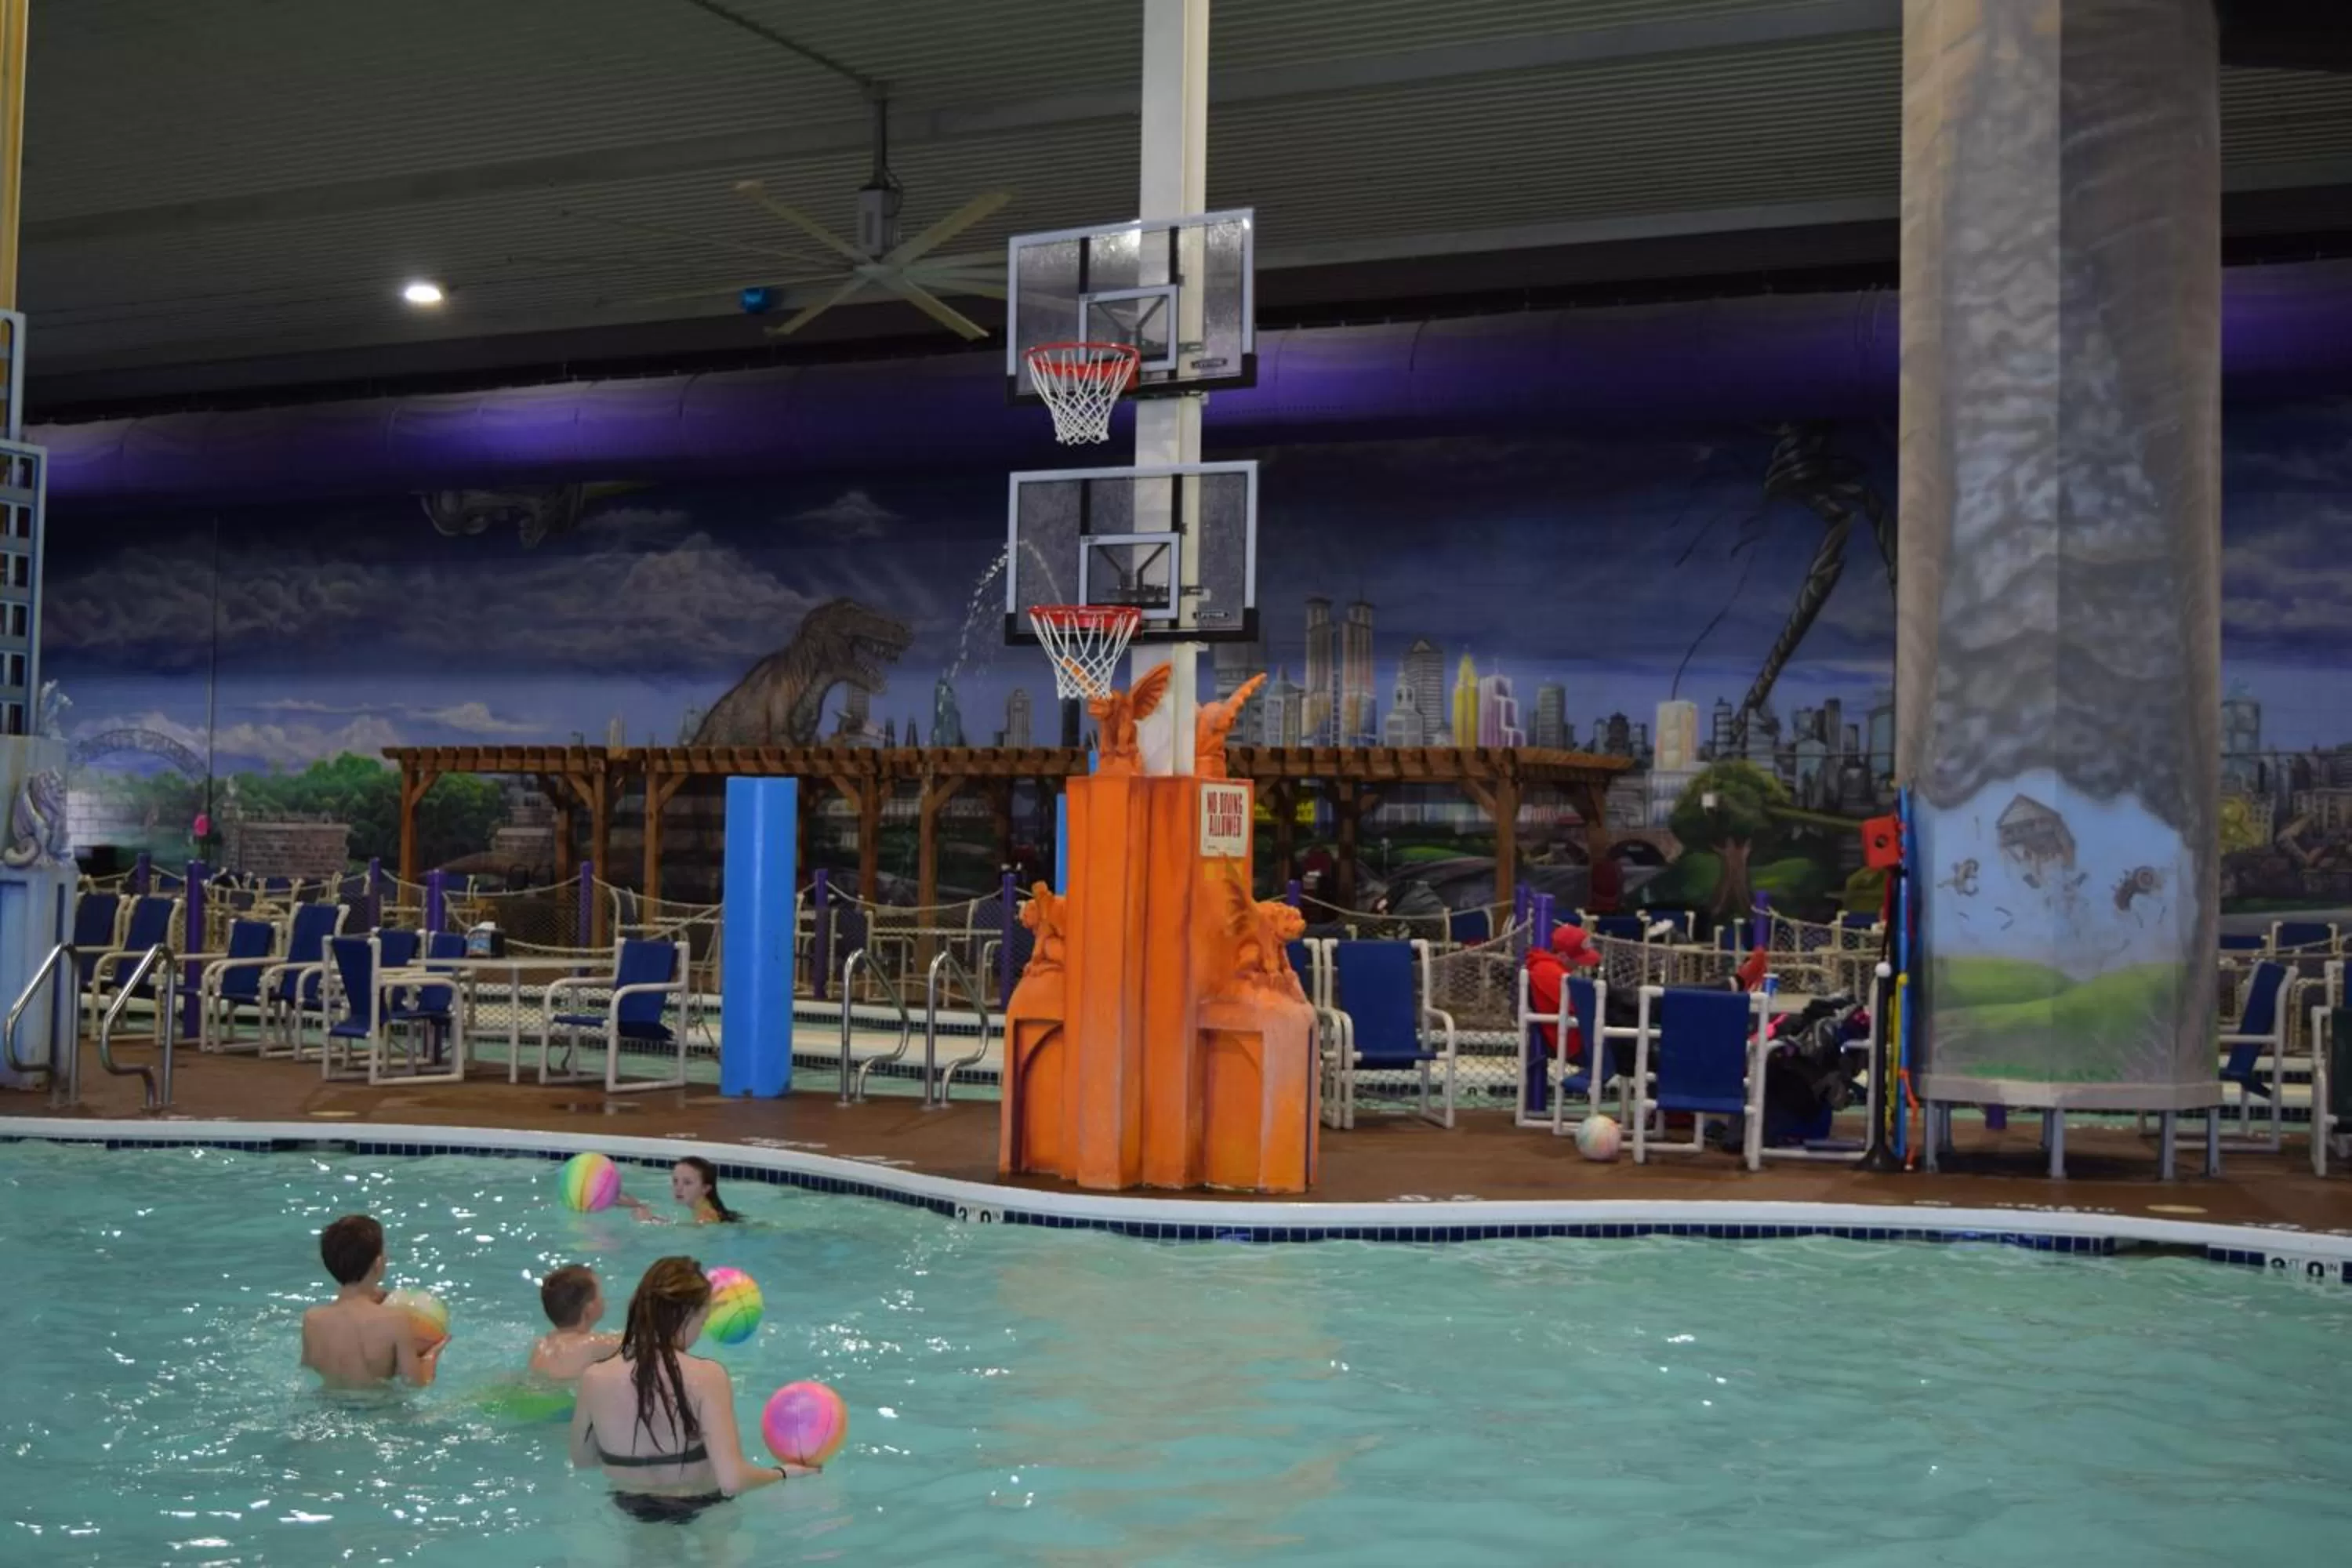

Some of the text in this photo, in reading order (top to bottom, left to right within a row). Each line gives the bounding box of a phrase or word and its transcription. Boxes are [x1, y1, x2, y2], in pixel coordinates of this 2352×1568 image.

[1207, 791, 1217, 814] NO
[1219, 791, 1243, 815] DIVING
[1208, 815, 1242, 838] ALLOWED
